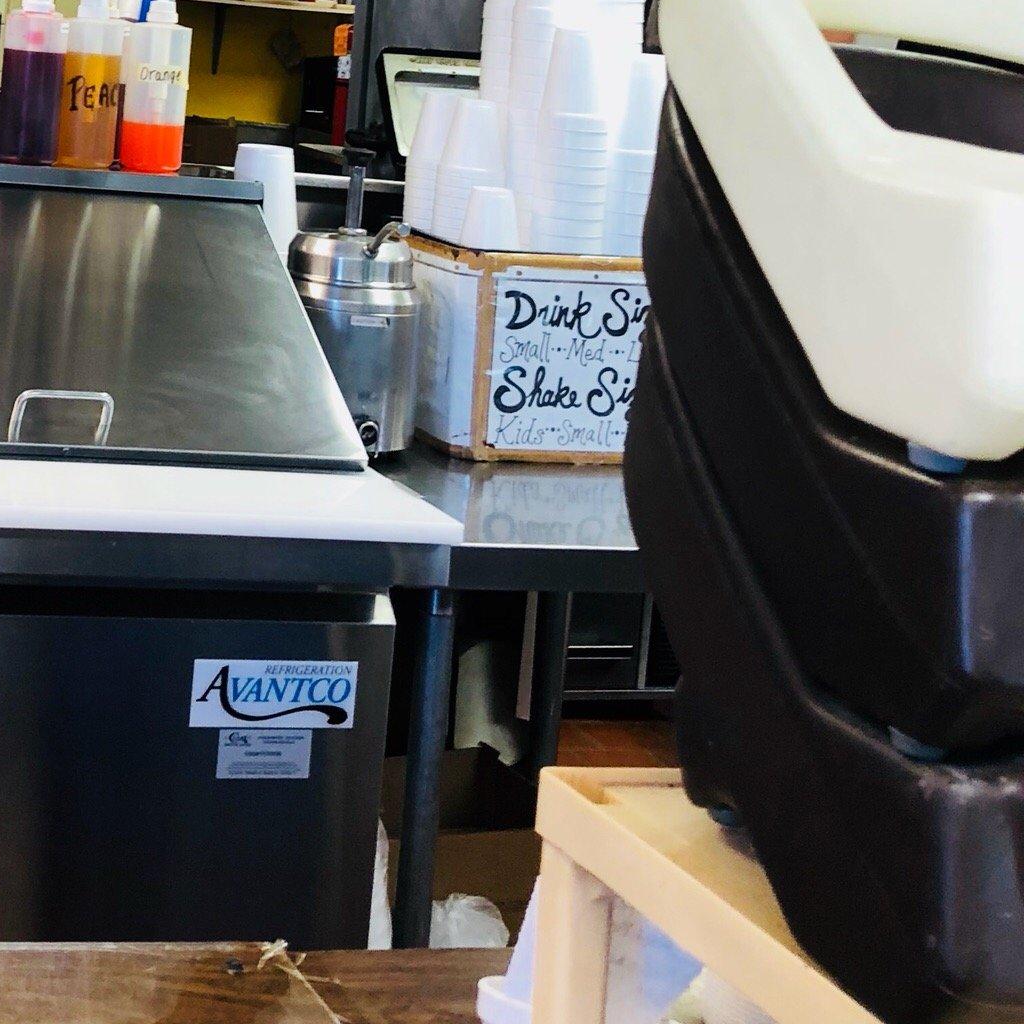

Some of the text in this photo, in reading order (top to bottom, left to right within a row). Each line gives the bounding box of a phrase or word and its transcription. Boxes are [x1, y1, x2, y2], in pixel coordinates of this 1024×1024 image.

[139, 66, 182, 84] Orange
[505, 290, 602, 339] Drink
[499, 331, 551, 363] Small
[566, 337, 607, 367] Med
[493, 365, 581, 414] Shake
[494, 414, 611, 447] Kids Small
[265, 665, 352, 675] REFRIGERATION
[196, 665, 351, 724] AVANTCO
